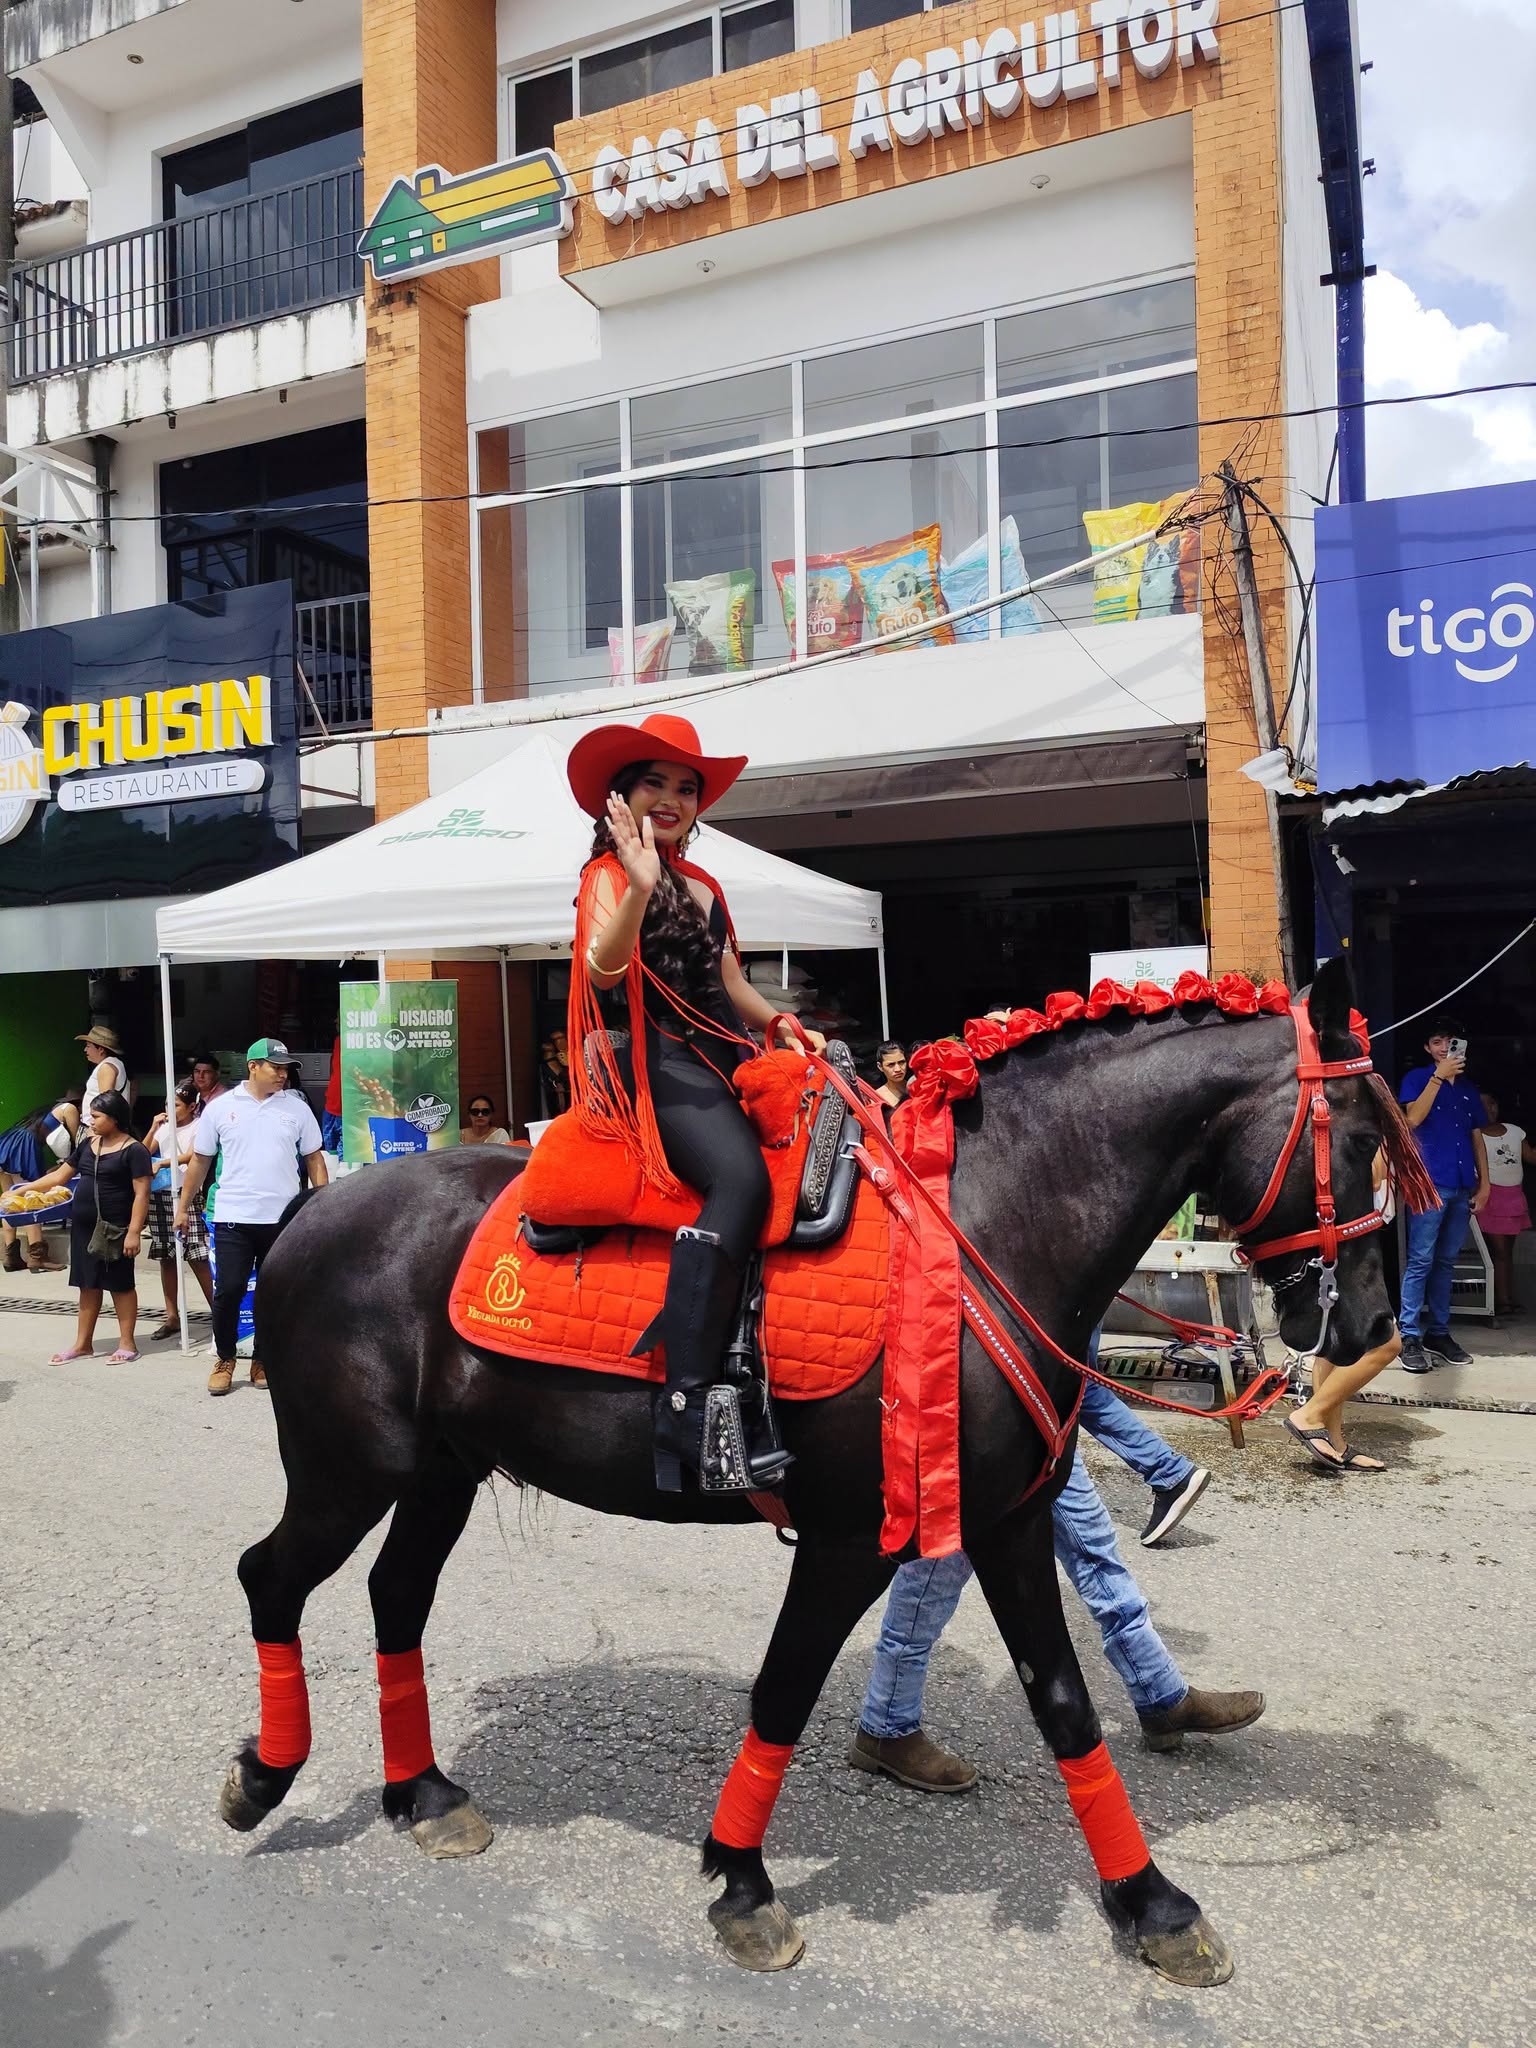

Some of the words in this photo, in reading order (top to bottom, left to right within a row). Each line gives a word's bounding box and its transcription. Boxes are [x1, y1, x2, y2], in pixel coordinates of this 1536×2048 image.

[592, 117, 729, 224] CASA
[736, 88, 839, 187] DEL
[848, 0, 1220, 159] AGRICULTOR
[808, 621, 833, 635] ufo
[884, 611, 920, 635] Rufo
[43, 675, 271, 776] CHUSIN
[74, 766, 238, 804] RESTAURANTE
[1116, 977, 1176, 988] DISRO
[347, 1010, 359, 1028] SI
[361, 1010, 377, 1027] NO
[400, 1009, 453, 1027] DISAGRO
[346, 1031, 364, 1049] NO
[366, 1031, 382, 1049] ES
[407, 1039, 453, 1048] XTEND
[409, 1031, 450, 1040] NITRO
[407, 1104, 450, 1121] COMPROBADO
